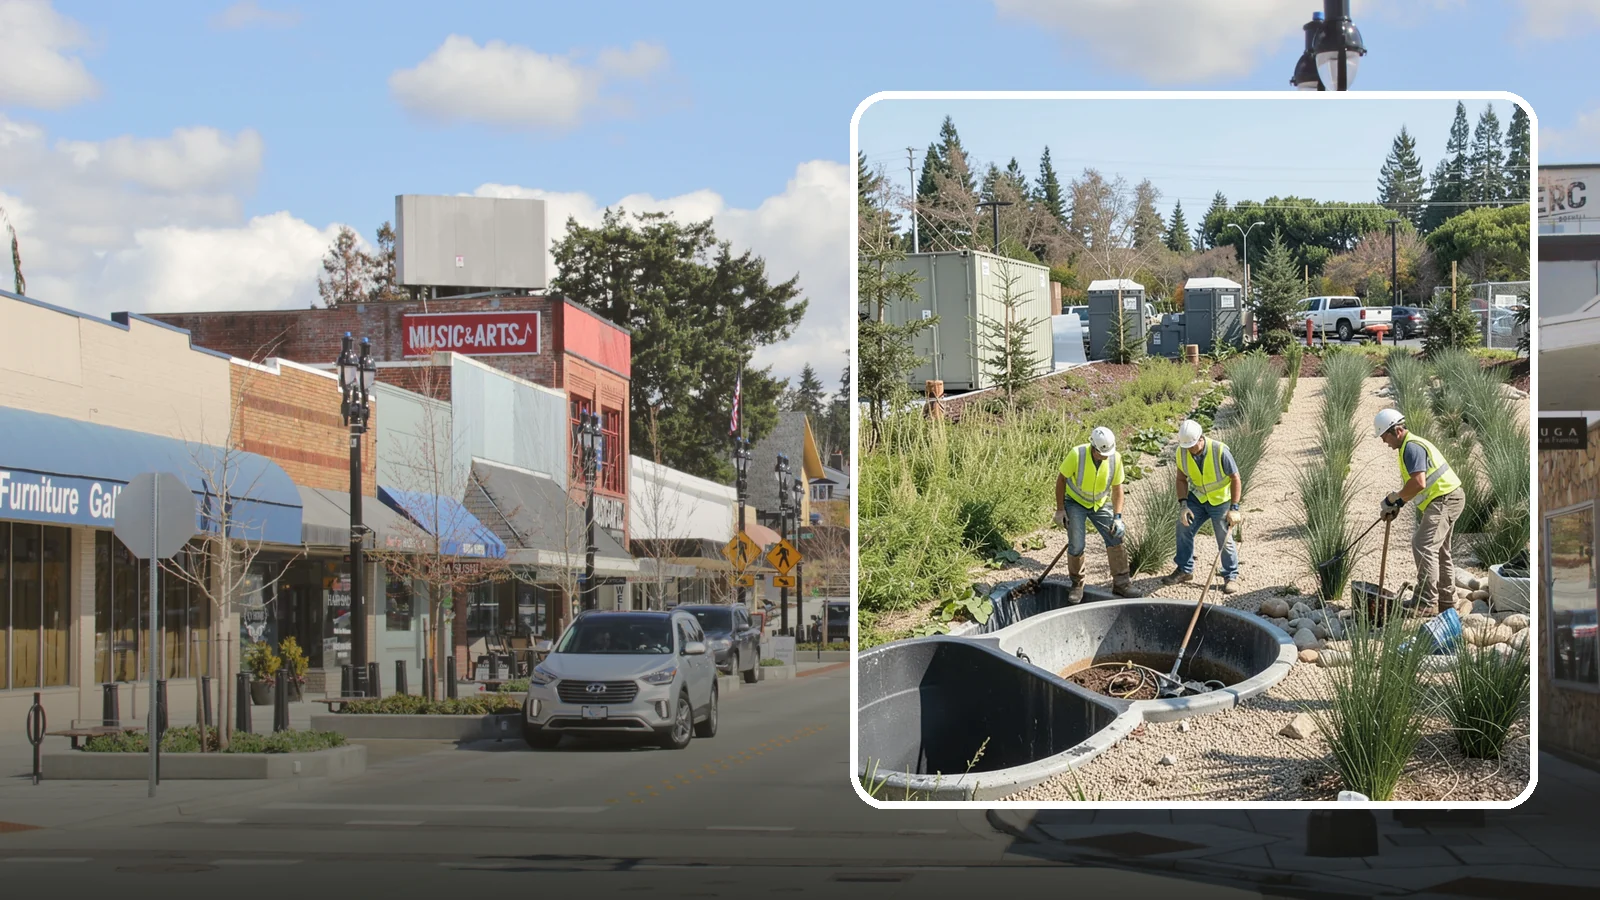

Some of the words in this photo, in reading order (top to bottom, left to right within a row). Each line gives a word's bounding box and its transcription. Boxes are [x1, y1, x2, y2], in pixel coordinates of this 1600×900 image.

[408, 322, 520, 349] MUSIC&ARTS
[0, 471, 79, 515] Furniture
[89, 482, 122, 519] Gal
